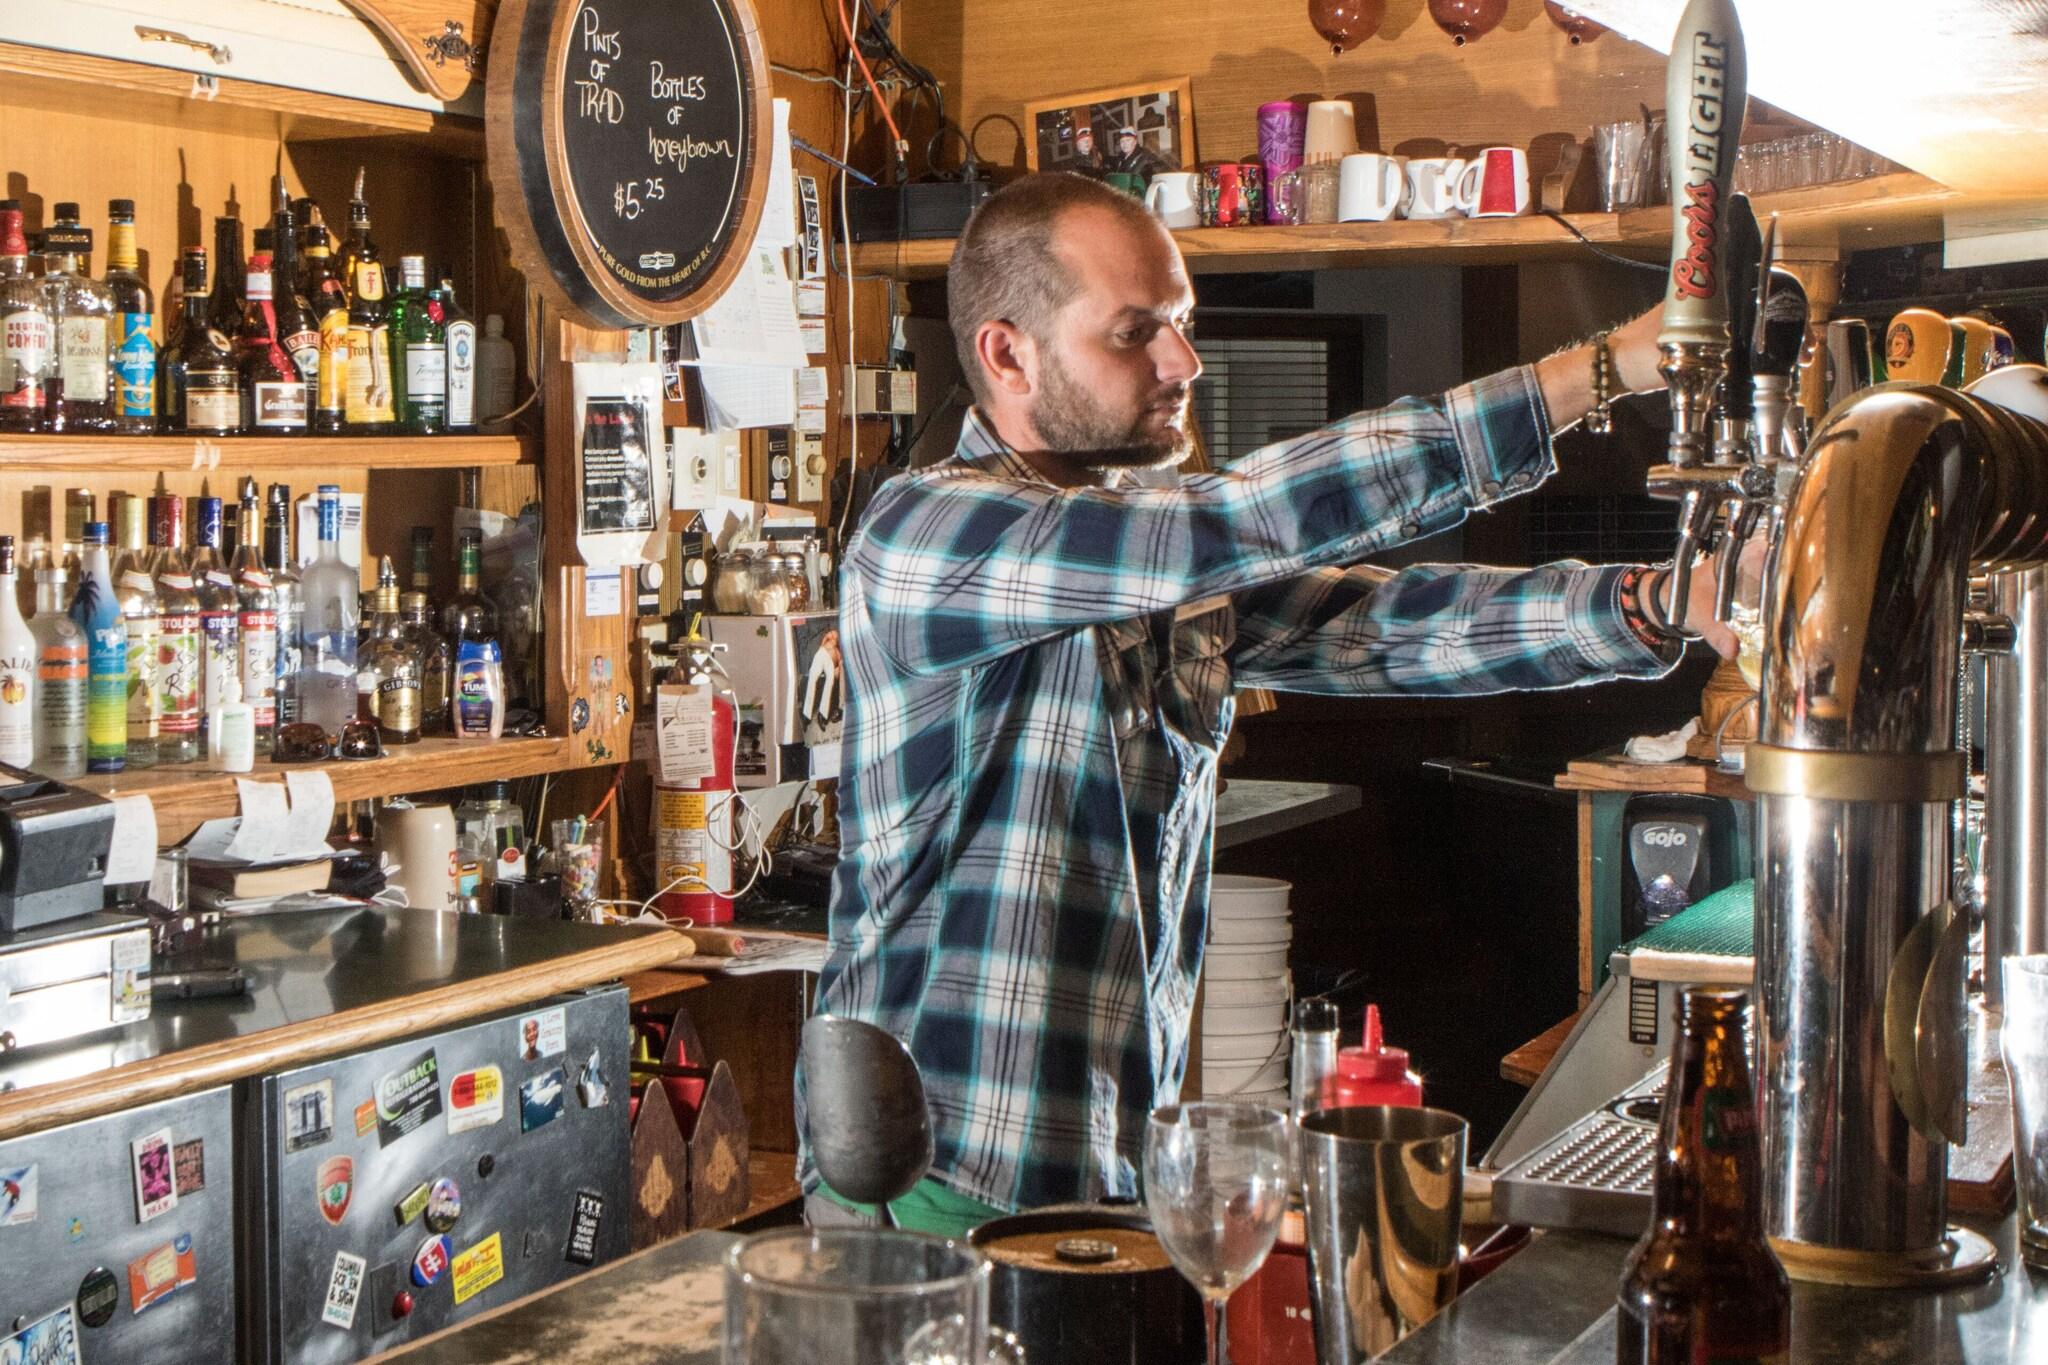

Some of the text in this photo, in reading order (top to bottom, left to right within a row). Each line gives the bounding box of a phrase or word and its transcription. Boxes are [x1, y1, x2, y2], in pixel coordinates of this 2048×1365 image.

[590, 59, 610, 83] OF
[575, 80, 624, 124] TRAD
[667, 107, 685, 126] OF
[1673, 31, 1728, 300] Coors LIGHT
[615, 263, 636, 284] GOLD
[636, 275, 657, 288] FROM
[658, 276, 671, 288] THE
[671, 265, 692, 284] HEART
[288, 333, 319, 349] BAILE
[384, 1057, 437, 1097] OUTBACK
